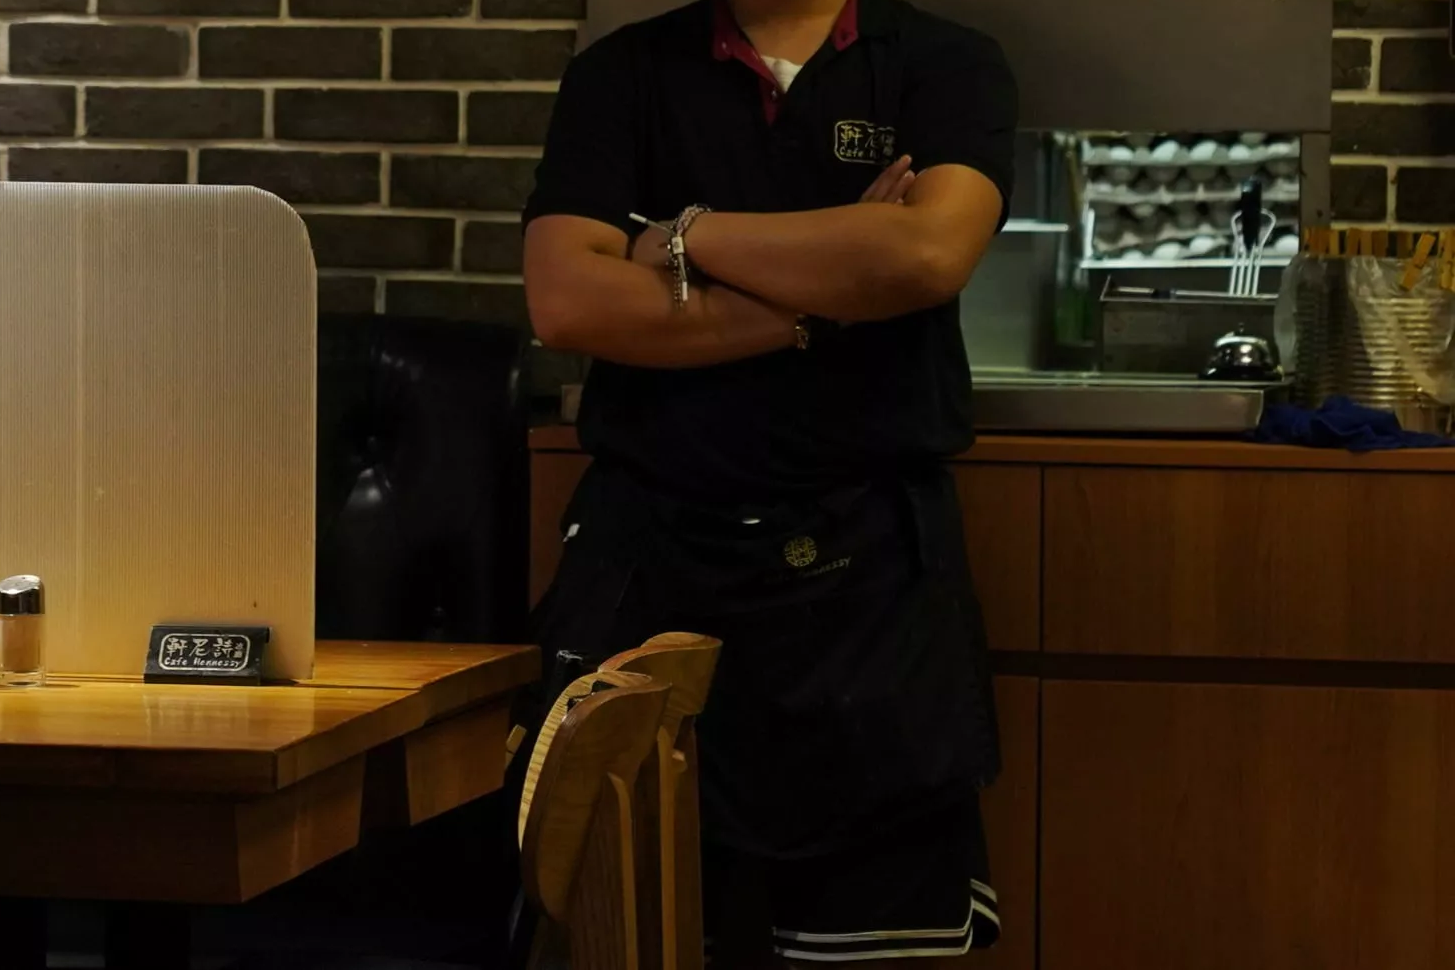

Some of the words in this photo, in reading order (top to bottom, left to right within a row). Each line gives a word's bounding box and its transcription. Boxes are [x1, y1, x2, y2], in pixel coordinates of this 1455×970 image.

[166, 637, 234, 659] 軒尼詩
[164, 657, 188, 667] Cafe
[193, 657, 243, 669] Hennessy
